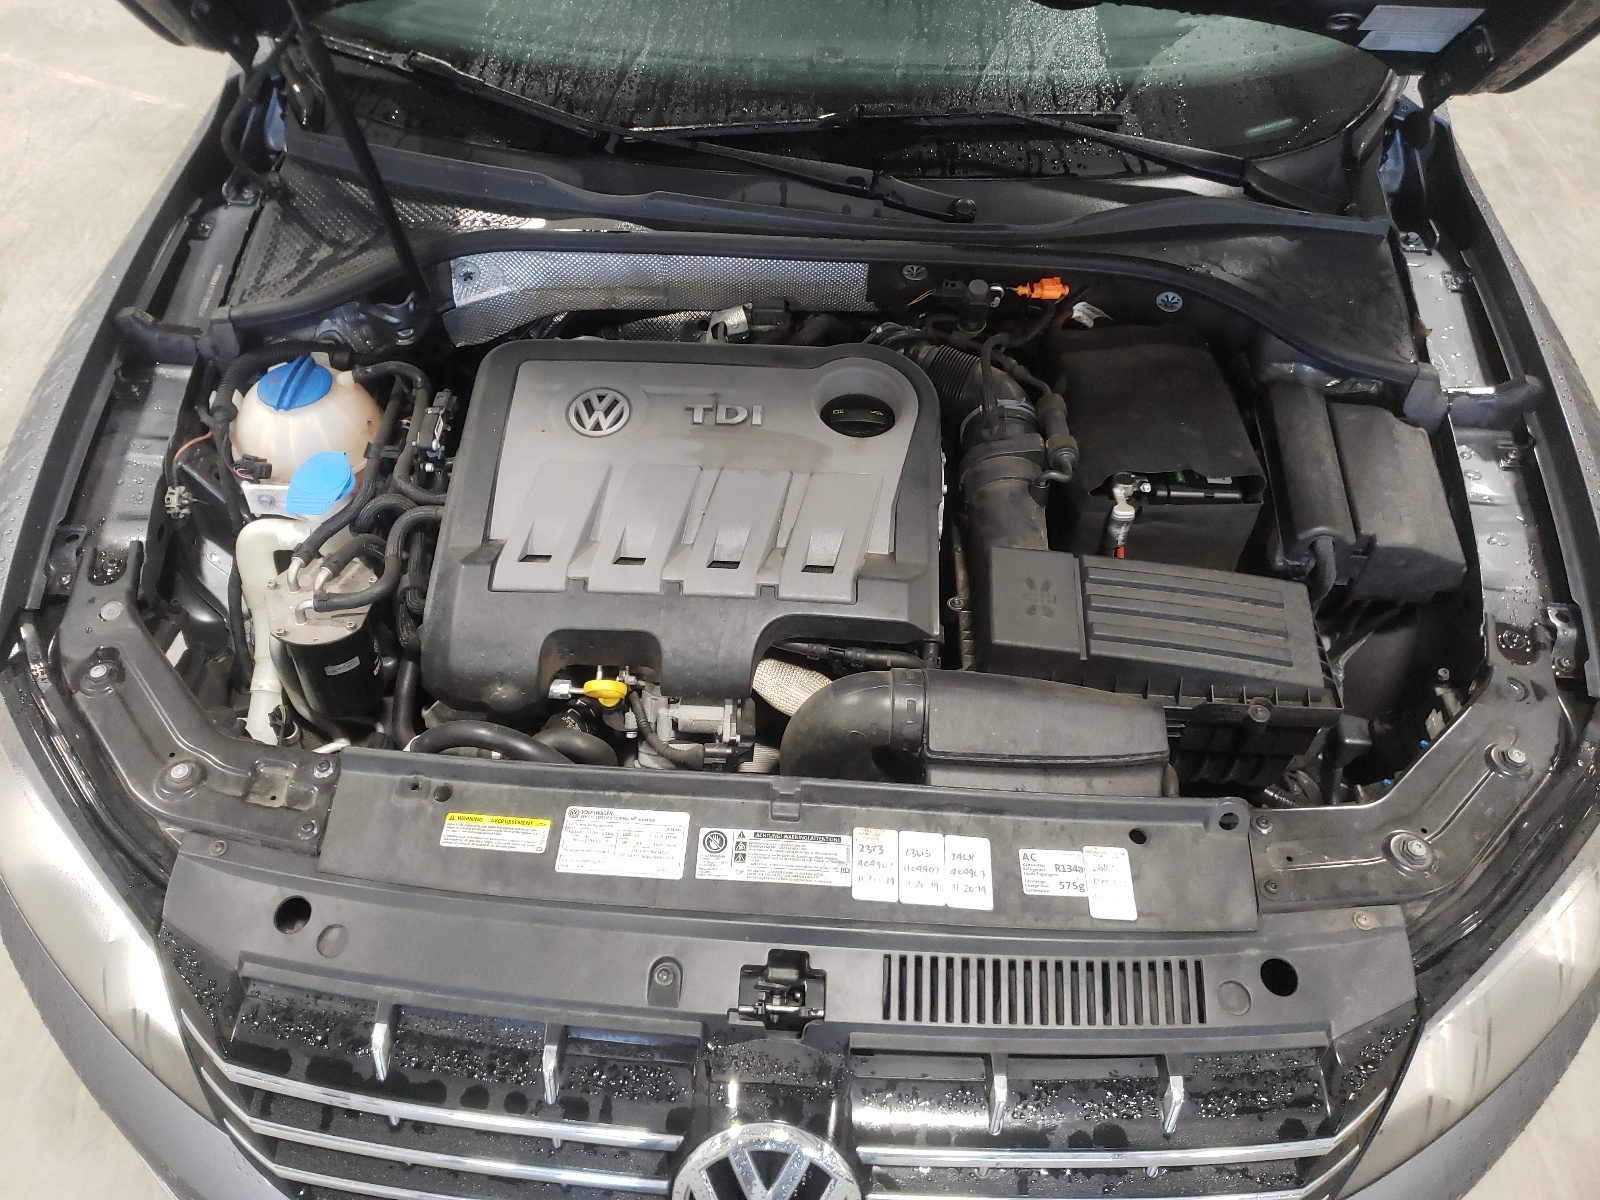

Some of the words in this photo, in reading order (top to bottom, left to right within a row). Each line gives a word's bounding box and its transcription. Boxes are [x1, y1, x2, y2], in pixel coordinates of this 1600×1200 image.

[685, 404, 764, 427] TDI
[1022, 853, 1037, 862] AC
[1055, 863, 1083, 874] R134a
[1059, 882, 1086, 893] 575g
